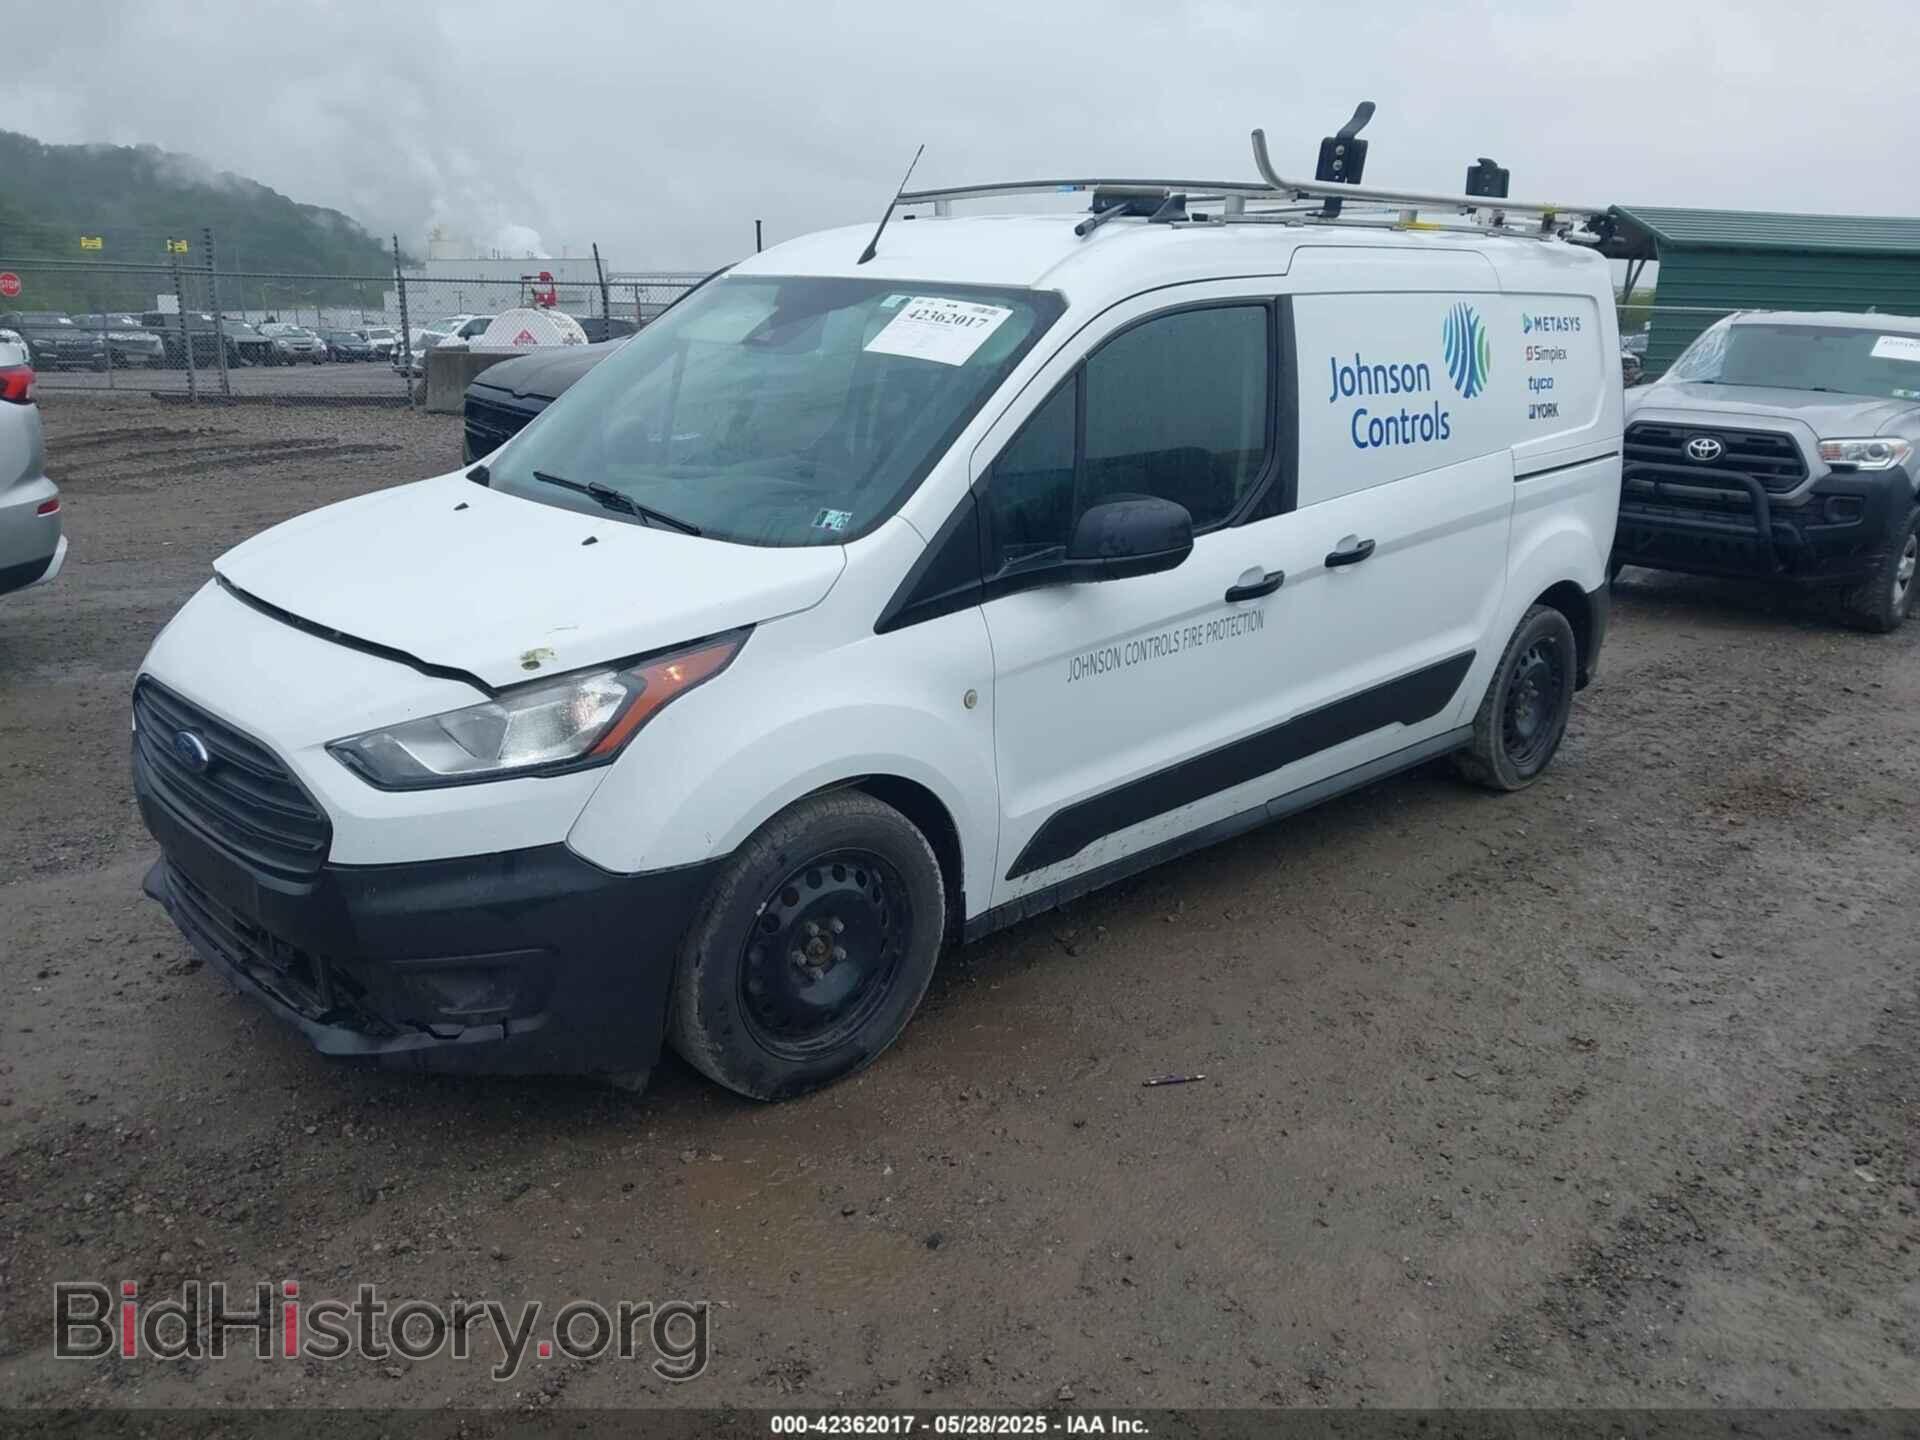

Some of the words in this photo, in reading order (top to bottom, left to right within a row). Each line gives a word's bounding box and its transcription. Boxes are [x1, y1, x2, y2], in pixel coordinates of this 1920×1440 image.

[0, 279, 20, 289] STOP
[908, 309, 989, 328] 42362017
[1534, 316, 1582, 333] METASYS
[1534, 345, 1568, 363] Simplex
[1329, 353, 1431, 404] Johnson
[1528, 376, 1554, 394] tyco
[1536, 403, 1559, 419] YORK
[1351, 401, 1450, 449] Controls
[1067, 647, 1121, 683] JOHNSON
[1124, 630, 1180, 666] CONTROLS
[1182, 624, 1204, 647] FIRE
[1206, 609, 1265, 641] PROTECTION
